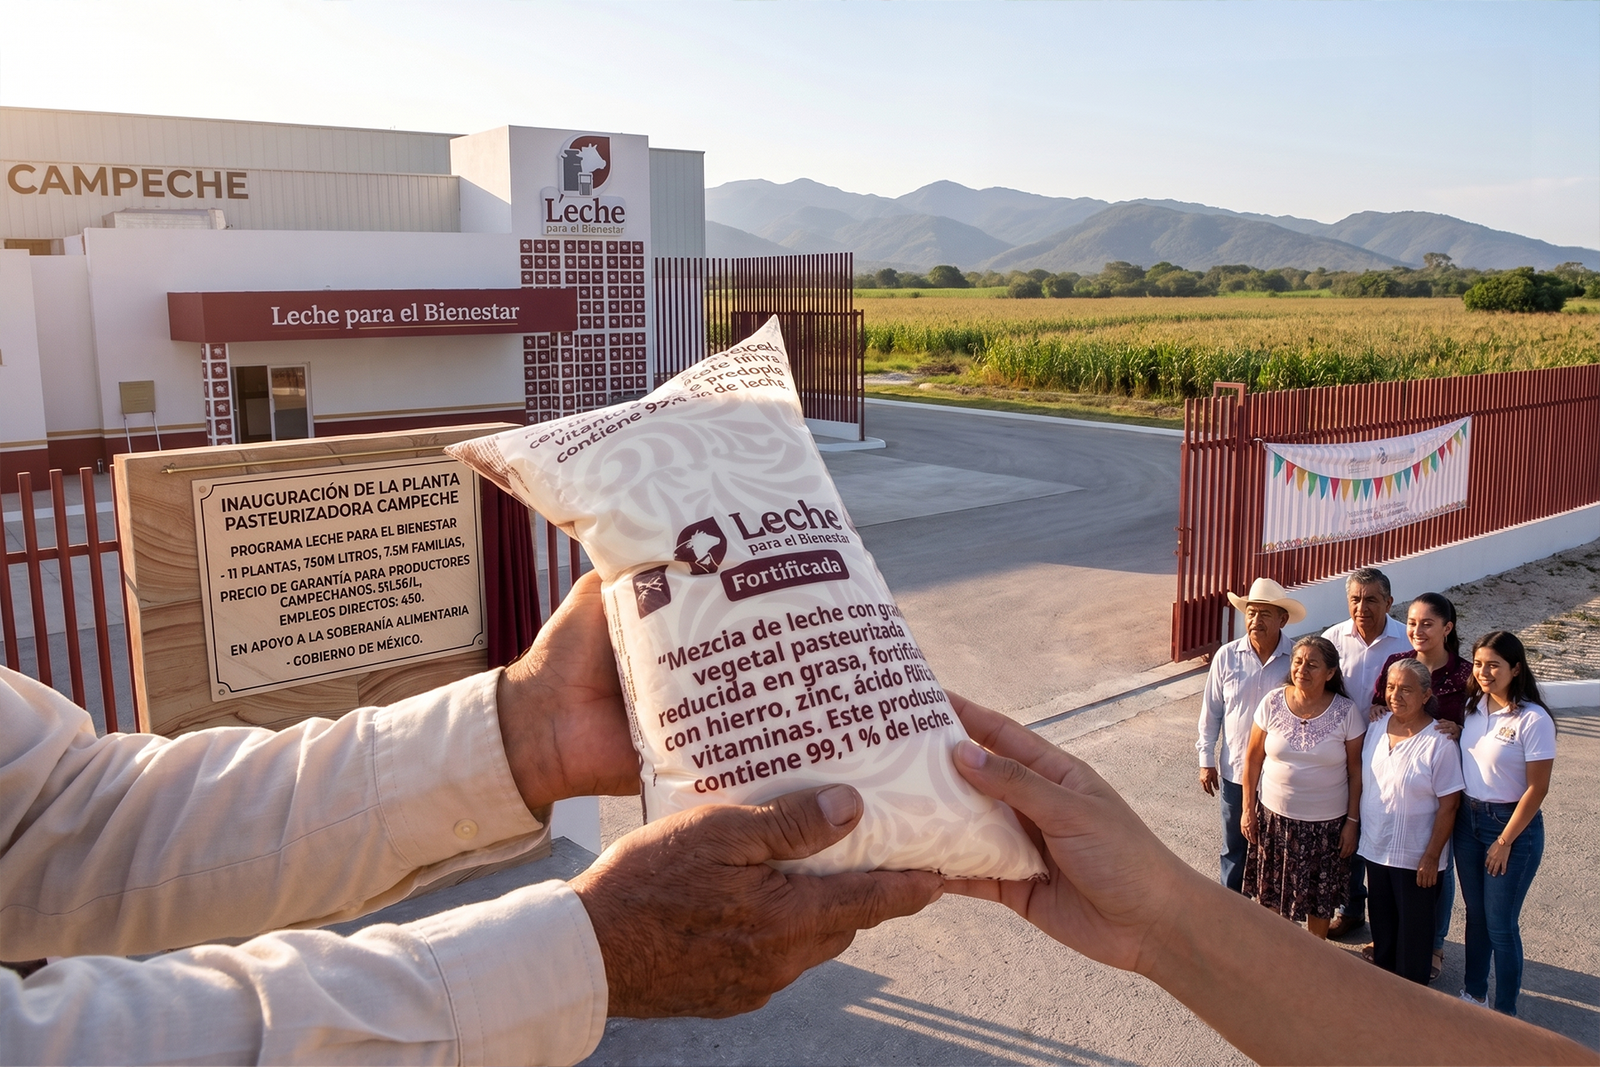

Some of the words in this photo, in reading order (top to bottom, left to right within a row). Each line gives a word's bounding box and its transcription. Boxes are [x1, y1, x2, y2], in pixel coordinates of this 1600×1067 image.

[8, 164, 248, 199] CAMPECHE
[546, 225, 567, 233] para
[570, 224, 579, 232] el
[582, 225, 624, 233] Bienestar
[271, 305, 340, 325] Leche
[345, 307, 394, 329] para
[400, 303, 419, 322] el
[424, 302, 519, 321] Bienestar
[557, 411, 642, 463] contiene
[714, 383, 738, 393] de
[221, 483, 349, 512] INAUGURACIÓN
[354, 481, 375, 497] DE
[379, 479, 398, 493] LA
[403, 472, 460, 491] PLANTA
[225, 501, 373, 531] PASTEURIZADORA
[377, 491, 459, 513] CAMPECHE
[230, 537, 302, 557] PROGRAMA
[306, 530, 344, 547] LECHE
[346, 528, 378, 542] PARA
[381, 526, 394, 538] EL
[397, 517, 457, 536] BIENESTAR
[728, 500, 842, 540] Leche
[228, 568, 238, 579] 11
[242, 560, 301, 578] PLANTAS,
[304, 553, 335, 569] 750M
[338, 547, 382, 564] LITROS,
[386, 544, 409, 558] 7.5M
[412, 536, 465, 554] FAMILIAS,
[748, 539, 782, 555] para
[785, 535, 796, 546] el
[220, 584, 267, 602] PRECIO
[270, 582, 287, 594] DE
[290, 571, 351, 593] GARANTÍA
[354, 567, 386, 582] PARA
[389, 555, 470, 576] PRODUCTORES
[280, 585, 376, 608] CAMPECHANOS.
[280, 608, 336, 626] EMPLEOS
[339, 597, 398, 616] DIRECTOS:
[402, 592, 424, 606] 450.
[752, 620, 782, 640] de
[786, 606, 844, 631] leche
[848, 604, 876, 618] con
[230, 643, 248, 656] EN
[251, 635, 294, 652] APOYO
[297, 633, 306, 644] A
[308, 630, 324, 642] LA
[327, 616, 394, 640] SOBERANÍA
[396, 605, 470, 626] ALIMENTARIA
[294, 646, 356, 667] GOBIERNO
[358, 642, 374, 654] DE
[377, 634, 423, 650] MÉXICO.
[692, 641, 785, 682] vegetal
[791, 621, 905, 662] pasteurizada
[658, 681, 756, 727] reducida
[763, 671, 794, 691] en
[800, 654, 866, 686] grasa,
[665, 726, 701, 751] con
[706, 701, 790, 737] hierro,
[795, 685, 849, 711] zinc,
[854, 668, 903, 695] ácido
[692, 719, 822, 769] vitaminas.
[826, 704, 874, 729] Este
[694, 752, 801, 793] contiene
[806, 732, 853, 764] 99,1
[859, 725, 880, 748] %
[886, 719, 909, 740] de
[911, 710, 953, 733] leche.
